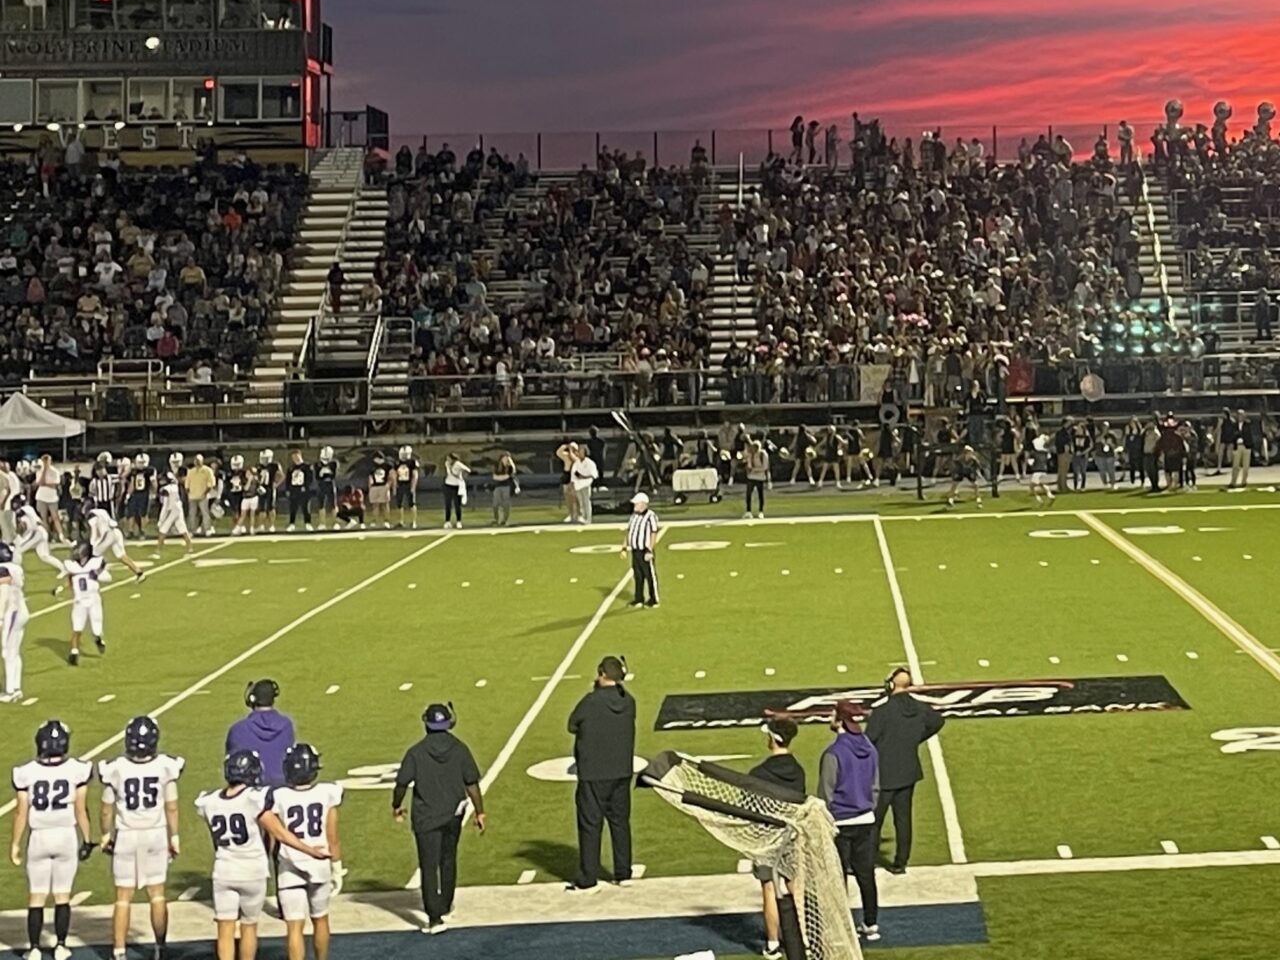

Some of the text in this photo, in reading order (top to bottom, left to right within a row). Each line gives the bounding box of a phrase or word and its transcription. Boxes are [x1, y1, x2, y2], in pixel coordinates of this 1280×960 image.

[6, 38, 248, 56] WOLVERINE TADIUM
[32, 779, 70, 811] 82
[124, 776, 160, 810] 85
[211, 812, 249, 846] 29
[287, 802, 323, 839] 28
